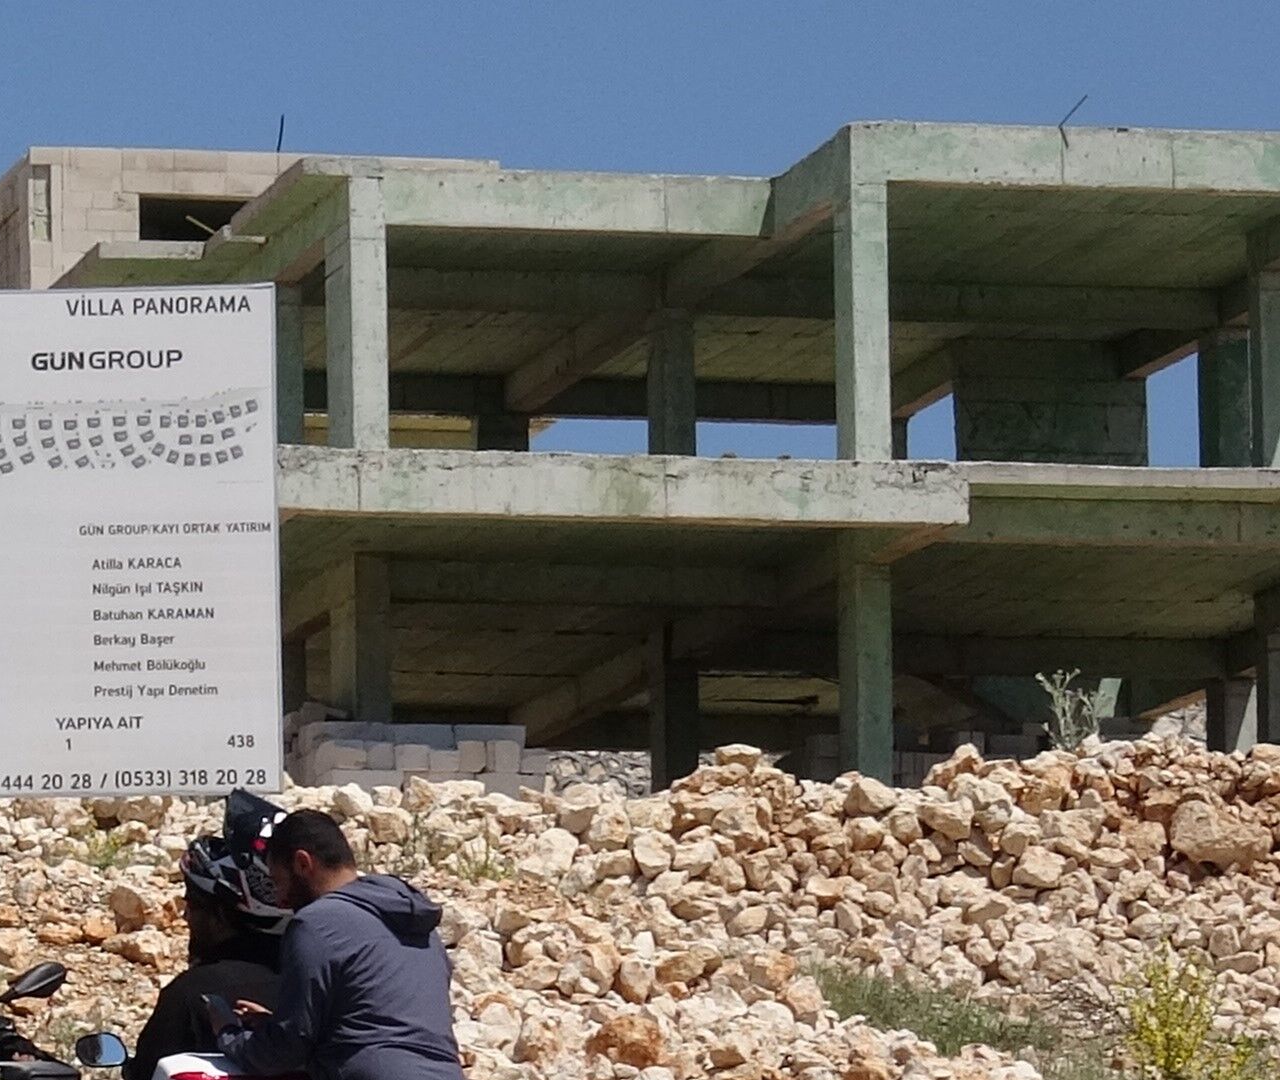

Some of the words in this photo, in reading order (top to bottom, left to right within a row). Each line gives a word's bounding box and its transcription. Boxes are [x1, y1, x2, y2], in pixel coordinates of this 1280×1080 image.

[66, 295, 124, 316] VİLLA
[133, 295, 251, 315] PANORAMA
[183, 523, 220, 534] ORTAK
[226, 521, 271, 533] YATIRIM
[92, 558, 123, 570] Atilla
[128, 557, 182, 569] KARACA
[92, 583, 131, 597] Nilgün
[157, 581, 203, 596] TAŞKIN
[92, 609, 143, 621] Batuhan
[147, 607, 215, 620] KARAMAN
[93, 634, 136, 648] Berkay
[140, 633, 175, 648] Başer
[93, 660, 142, 672] Mehmet
[93, 685, 133, 699] Prestij
[137, 684, 165, 699] Yapı
[168, 683, 218, 697] Denetim
[55, 716, 114, 730] YAPIYA
[65, 738, 71, 751] 1
[227, 734, 255, 748] 438
[1, 775, 34, 790] 444
[41, 774, 63, 790] 20
[71, 773, 92, 790] 28
[115, 770, 171, 788] (0533)
[178, 769, 208, 786] 318
[216, 769, 237, 785] 20
[245, 769, 266, 785] 28
